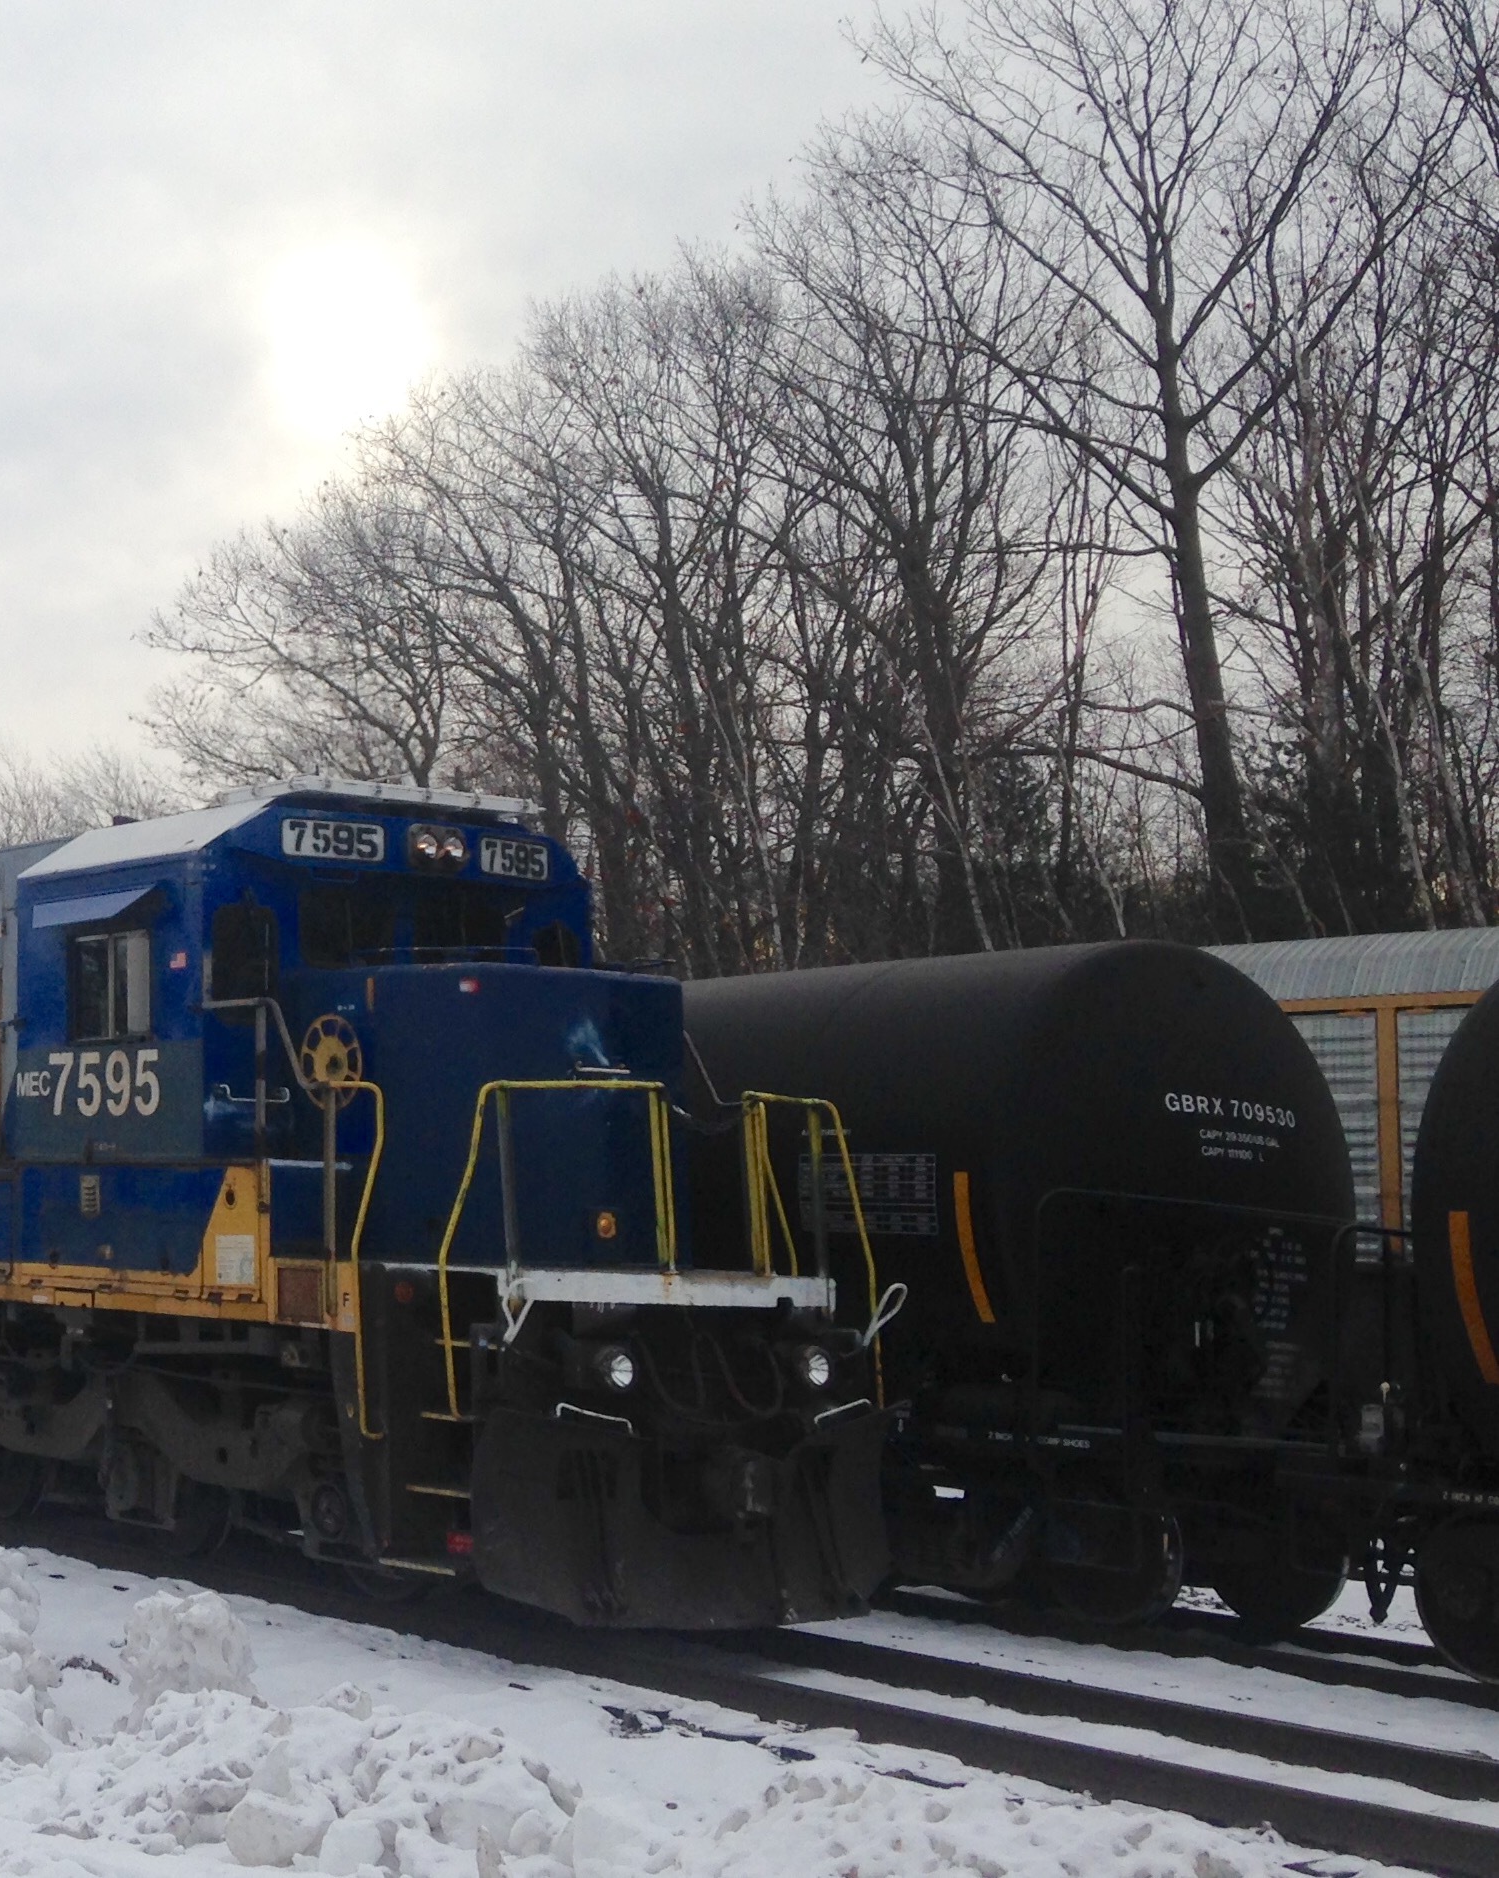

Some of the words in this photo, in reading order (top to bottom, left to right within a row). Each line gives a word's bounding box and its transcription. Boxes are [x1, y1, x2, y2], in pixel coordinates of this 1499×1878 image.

[288, 820, 379, 859] 7595
[484, 840, 545, 878] 7595
[16, 1070, 51, 1097] MEC
[48, 1048, 160, 1117] 7595
[1164, 1092, 1224, 1116] GBRX
[1230, 1099, 1296, 1128] 709530
[1199, 1128, 1223, 1140] CAPY
[1201, 1145, 1225, 1157] CAPY
[343, 1292, 350, 1307] F
